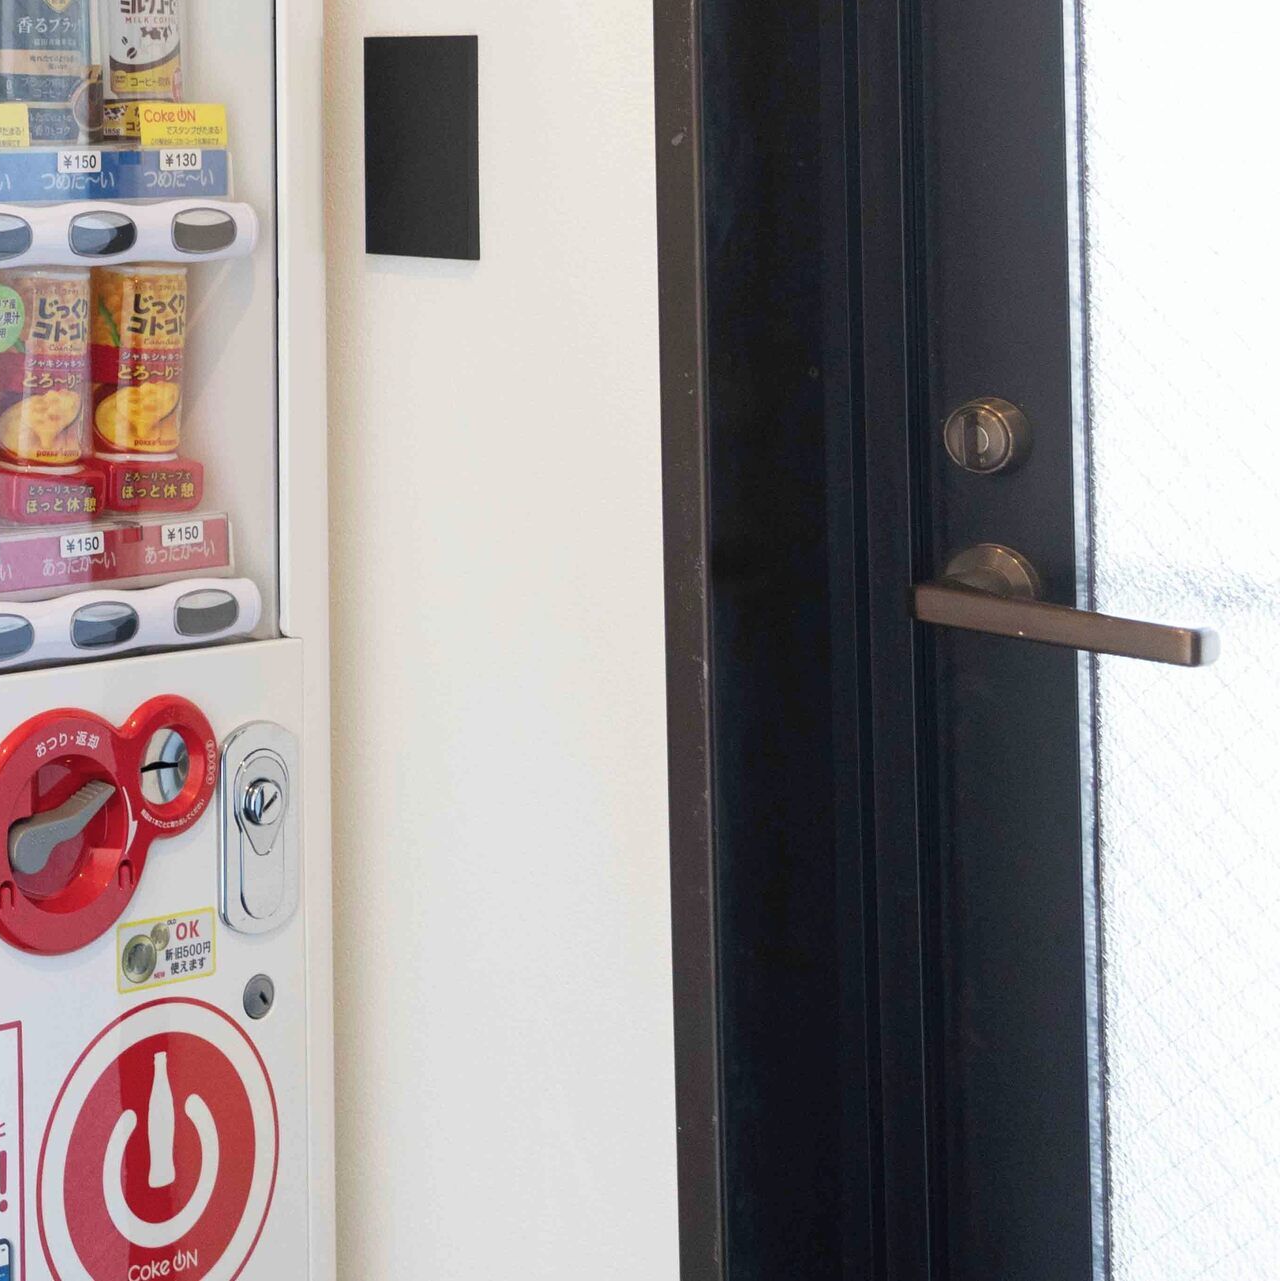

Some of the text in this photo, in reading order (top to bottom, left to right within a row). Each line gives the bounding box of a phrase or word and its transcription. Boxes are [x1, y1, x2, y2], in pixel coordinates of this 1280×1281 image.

[165, 153, 197, 167] ¥130
[39, 297, 88, 320] じっくり
[121, 483, 194, 498] ほっと休憩
[26, 497, 97, 513] ほっと休憩
[35, 731, 101, 759] おつり・返却
[176, 920, 199, 941] OK
[171, 957, 206, 975] 使えます
